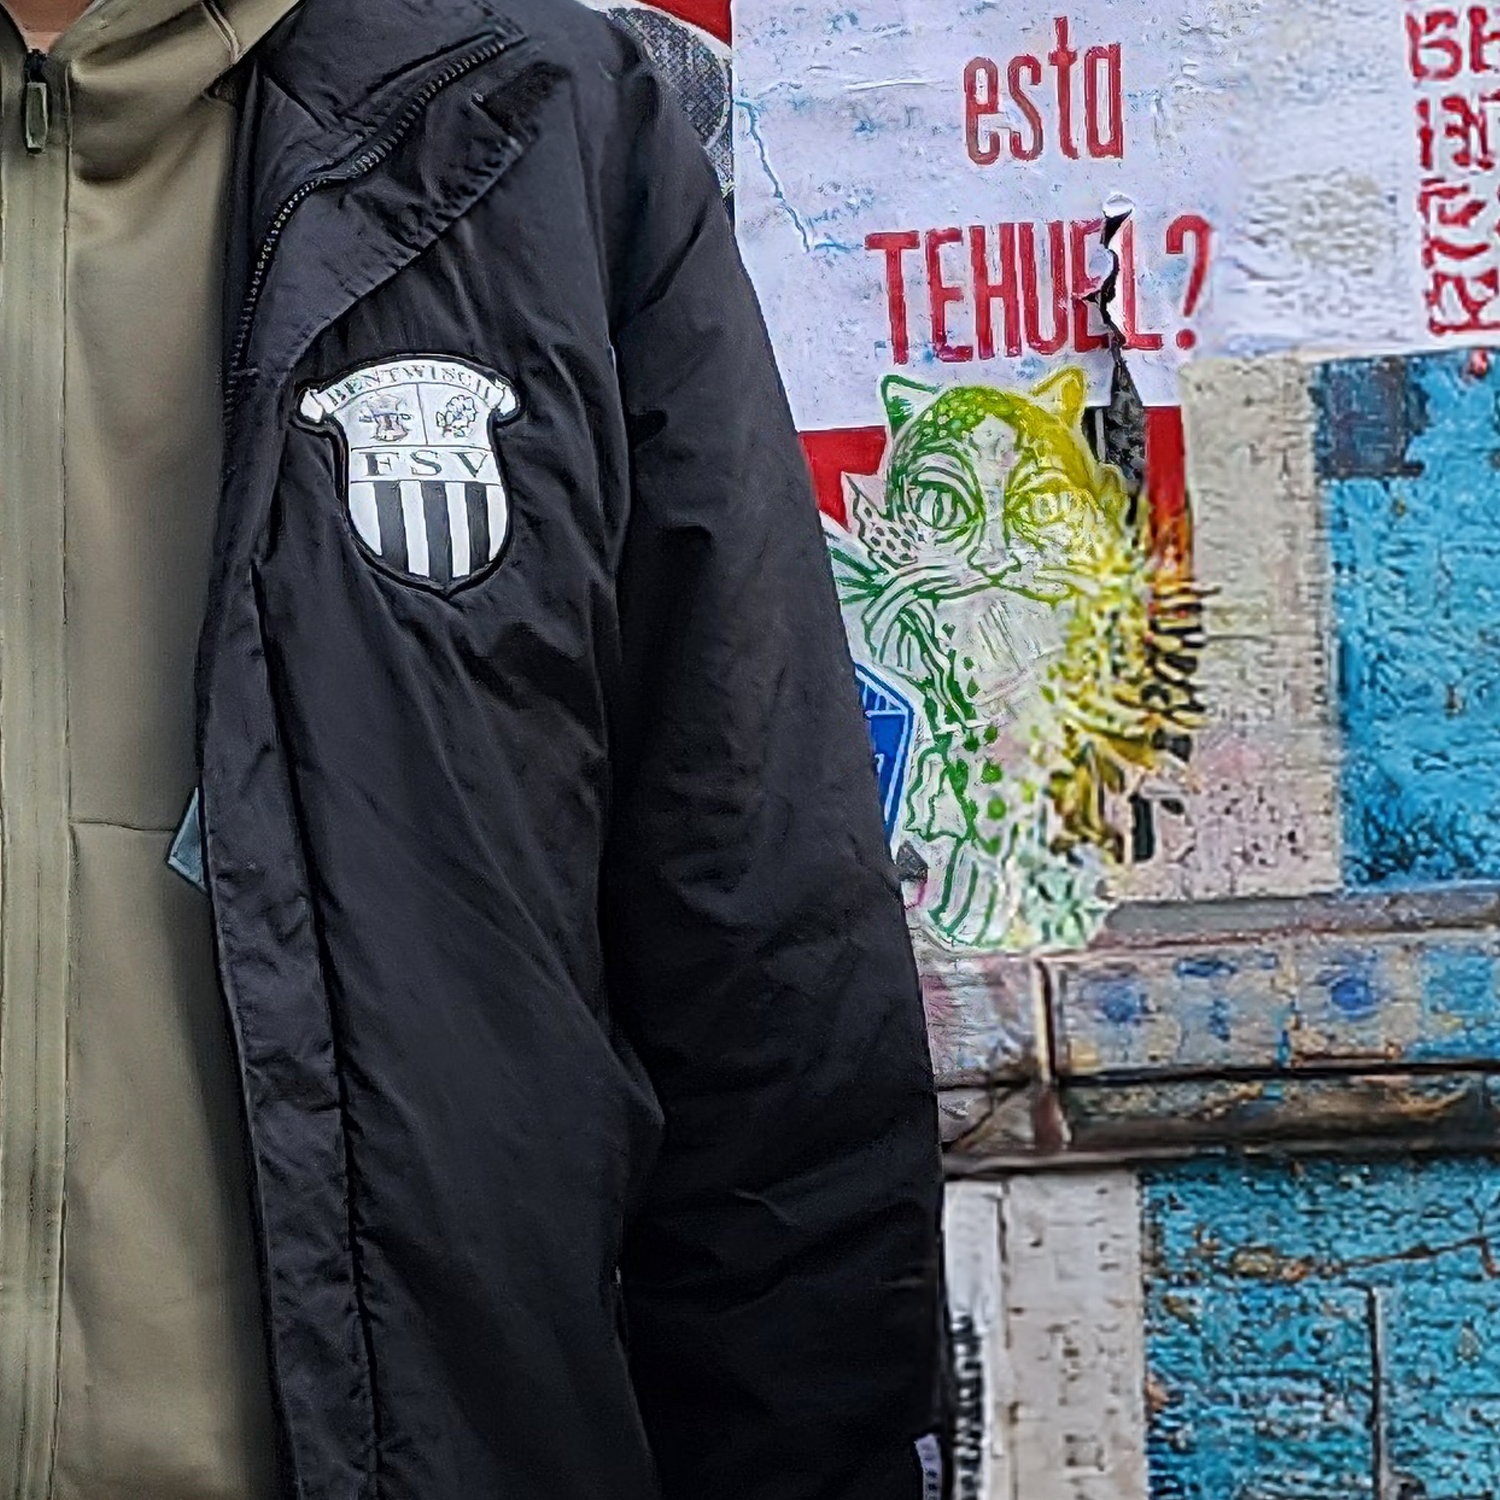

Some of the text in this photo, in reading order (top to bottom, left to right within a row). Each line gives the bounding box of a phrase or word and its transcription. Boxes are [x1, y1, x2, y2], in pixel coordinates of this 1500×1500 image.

[963, 16, 1127, 167] esta
[864, 214, 1216, 366] TEHUEL?
[358, 449, 490, 478] FSV
